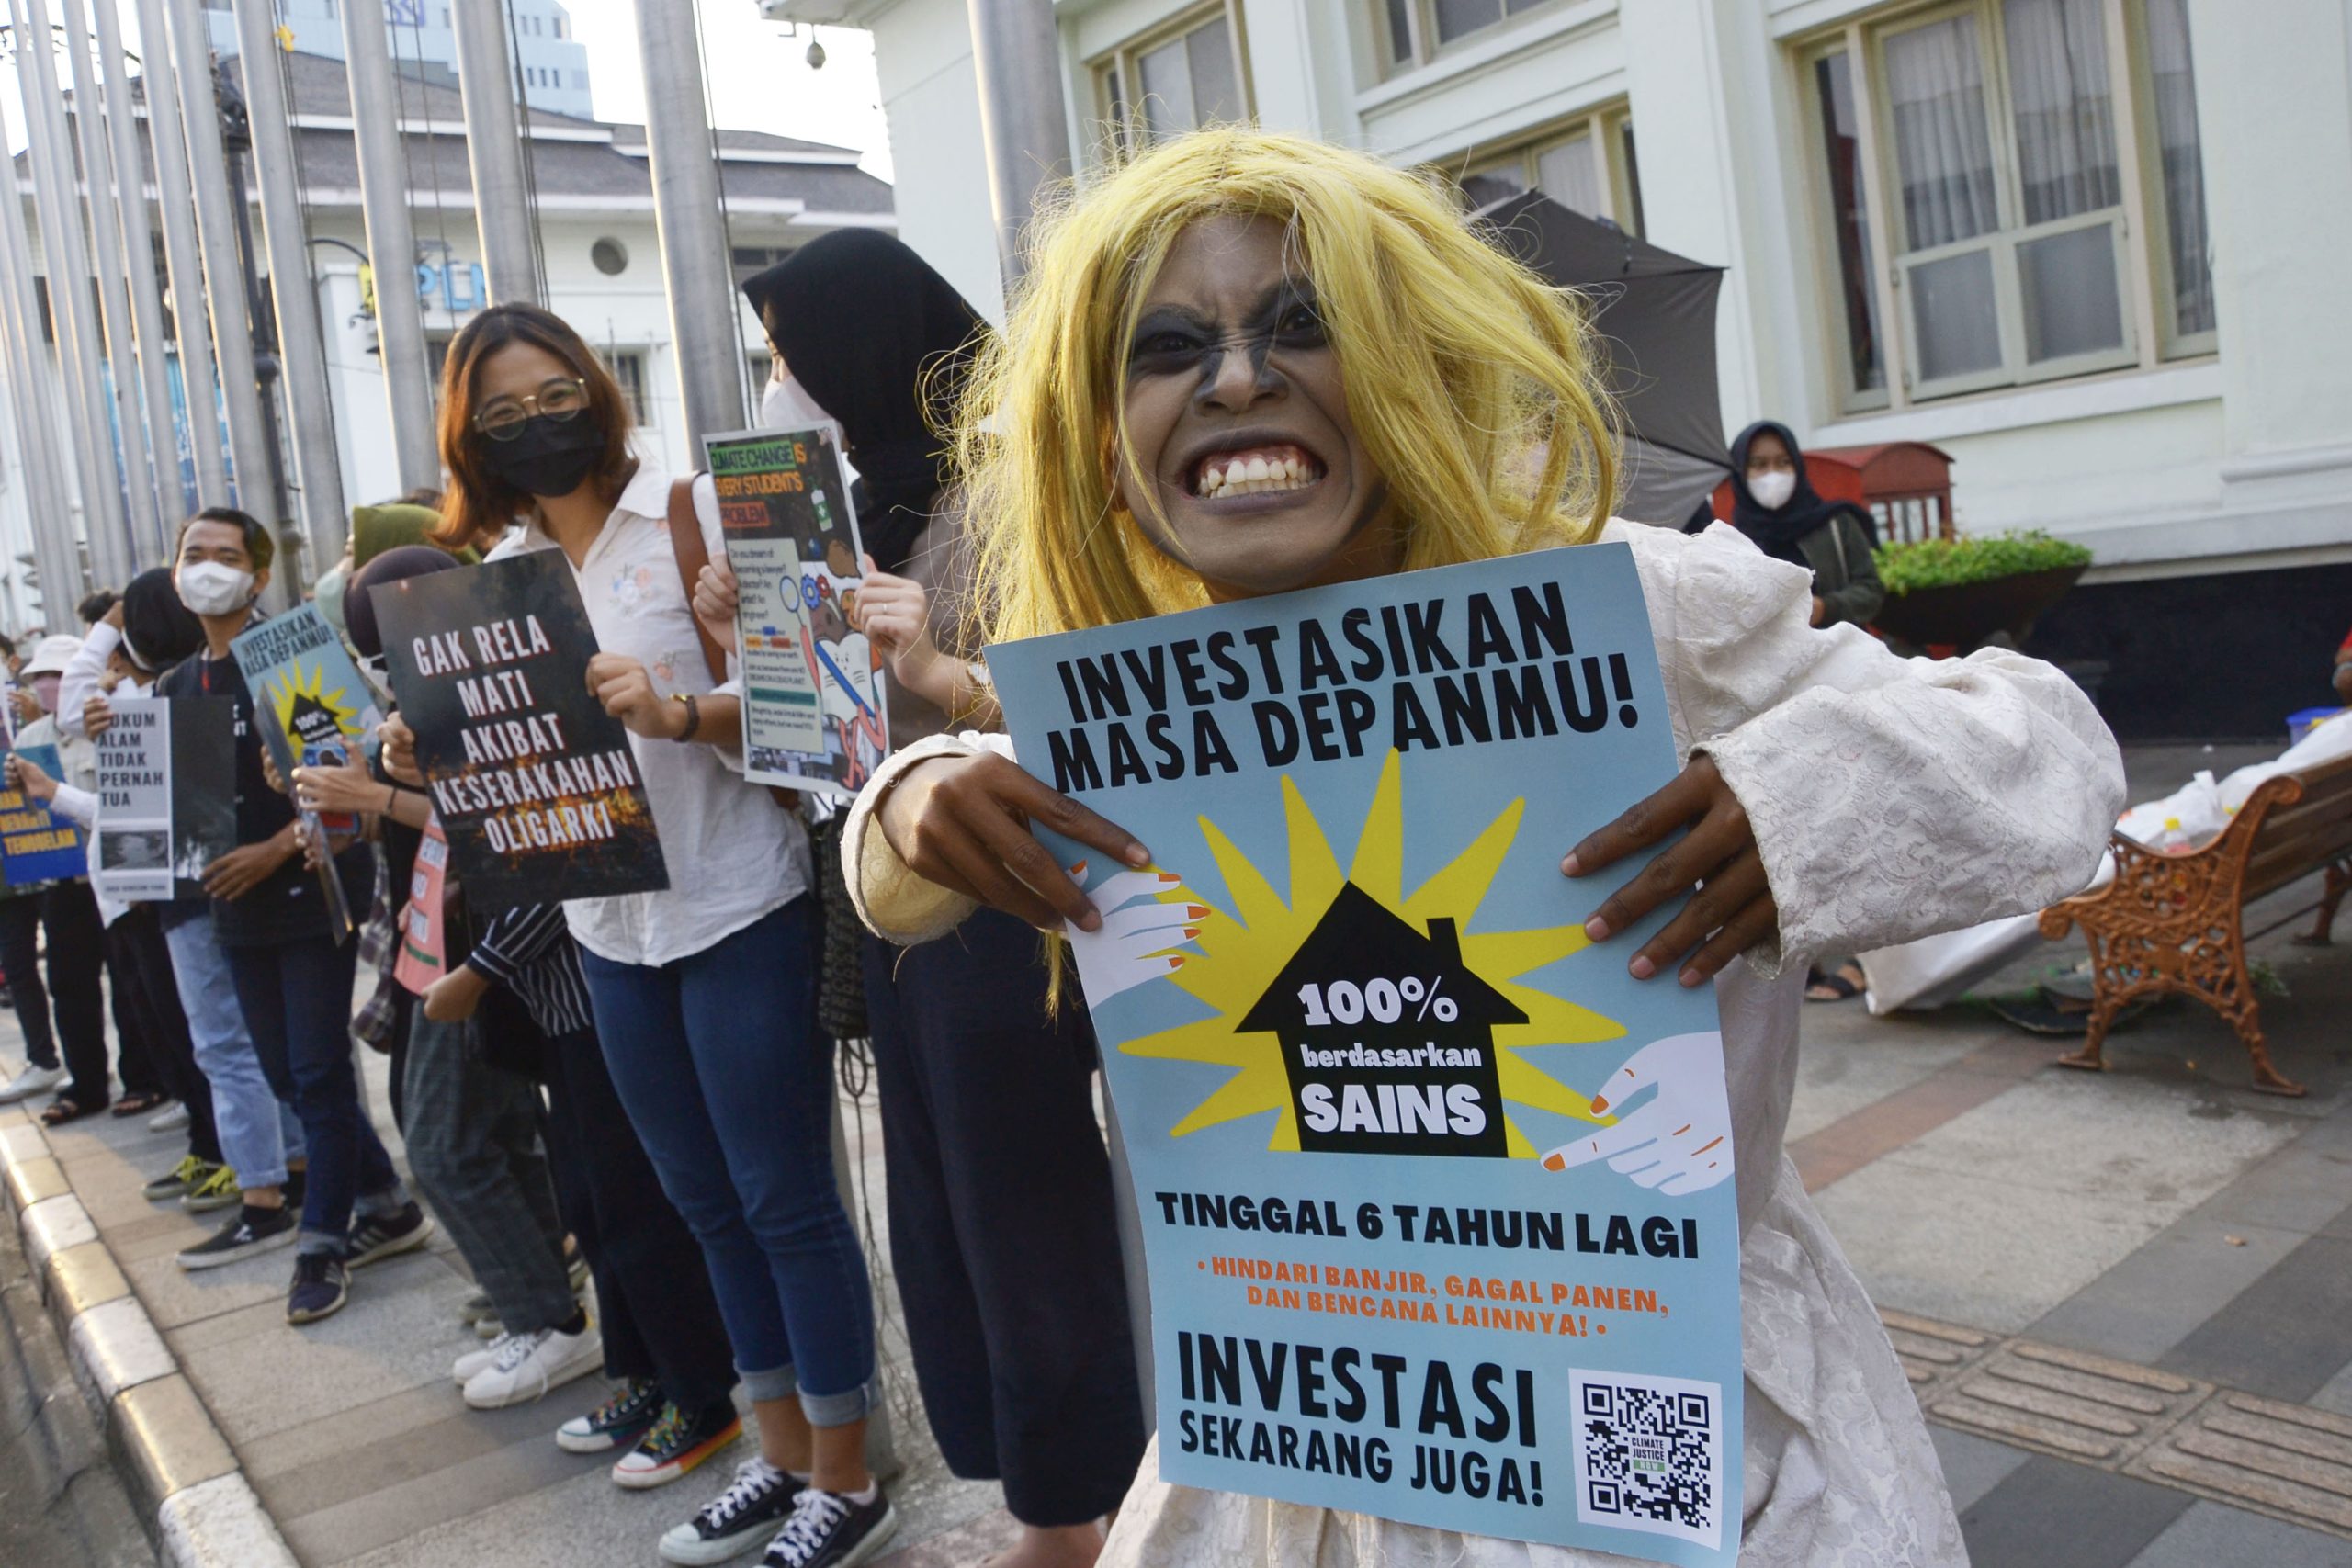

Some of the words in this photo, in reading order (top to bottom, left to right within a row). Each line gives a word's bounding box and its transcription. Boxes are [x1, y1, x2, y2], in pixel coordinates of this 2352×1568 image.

[746, 445, 794, 468] CHANGE
[413, 630, 469, 676] GAK
[473, 615, 550, 664] RELA
[1057, 581, 1576, 723] INVESTASIKAN
[457, 670, 534, 717] MATI
[98, 733, 141, 748] ALAM
[461, 713, 565, 764] AKIBAT
[1046, 709, 1238, 794] MASA
[1252, 652, 1640, 768] DEPANMU!
[99, 752, 147, 768] TIDAK
[100, 772, 163, 787] PERNAH
[432, 750, 635, 815] KESERAKAHAN
[101, 792, 131, 807] TUA
[484, 801, 615, 853] OLIGARKI
[1297, 975, 1459, 1026] 100%
[1299, 1042, 1483, 1068] berdasarkan
[1300, 1083, 1487, 1136] SAINS
[1155, 1191, 1347, 1237] TINGGAL
[1356, 1202, 1385, 1240] 6
[1393, 1204, 1563, 1251] TAHUN
[1575, 1213, 1700, 1259] LAGI
[1212, 1256, 1319, 1285] HINDARI
[1325, 1266, 1438, 1300] BANJIR,
[1445, 1274, 1544, 1304] GAGAL
[1551, 1283, 1669, 1319] PANEN,
[1247, 1286, 1301, 1310] DAN
[1308, 1292, 1439, 1325] BENCANA
[1446, 1303, 1589, 1337] LAINNYA!
[1176, 1331, 1538, 1449] INVESTASI
[1180, 1410, 1393, 1483] SEKARANG
[1410, 1444, 1544, 1507] JUGA!
[1631, 1437, 1664, 1450] CLIMATE
[1633, 1447, 1665, 1461] JUSTICE
